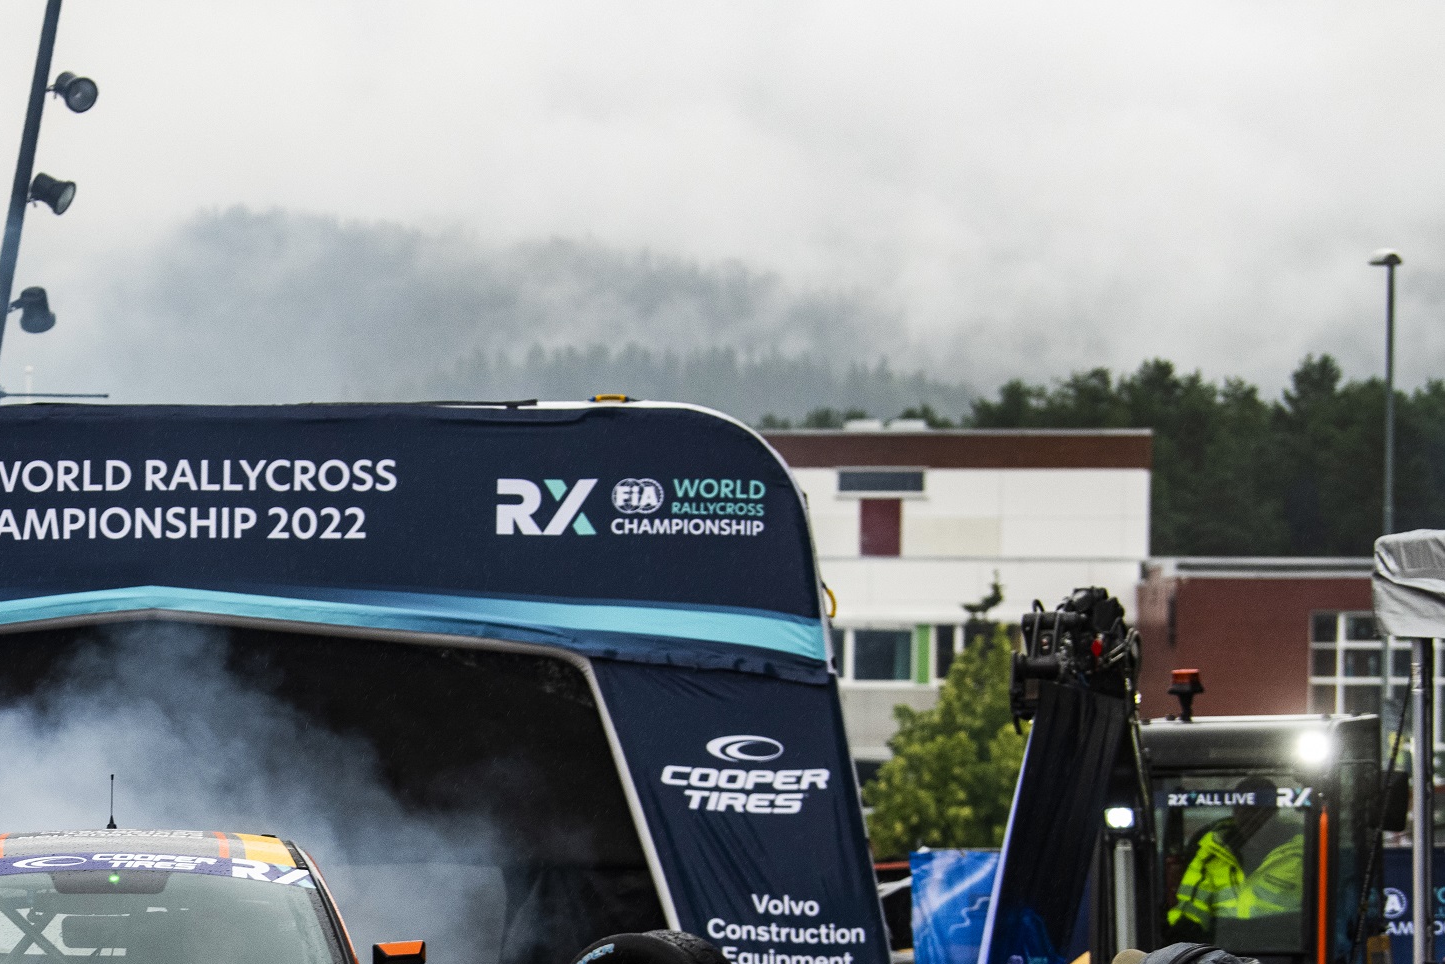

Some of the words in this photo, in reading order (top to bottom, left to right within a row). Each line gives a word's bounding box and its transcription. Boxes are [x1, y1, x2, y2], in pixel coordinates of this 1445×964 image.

[144, 459, 398, 492] RALLYCROSS
[673, 478, 766, 500] WORLD
[496, 478, 599, 535] RX
[671, 502, 764, 517] RALLYCROSS
[266, 506, 367, 540] 2022
[611, 518, 764, 536] CHAMPIONSHIP
[661, 765, 830, 790] COOPER
[683, 789, 804, 814] TIRES
[1196, 793, 1221, 806] ALL
[1224, 793, 1255, 805] LIVE
[1276, 788, 1312, 807] RX
[92, 853, 218, 865] COOPER
[106, 860, 198, 870] TIRES
[231, 857, 316, 888] RX
[751, 894, 820, 917] Volvo
[707, 918, 866, 944] Construction
